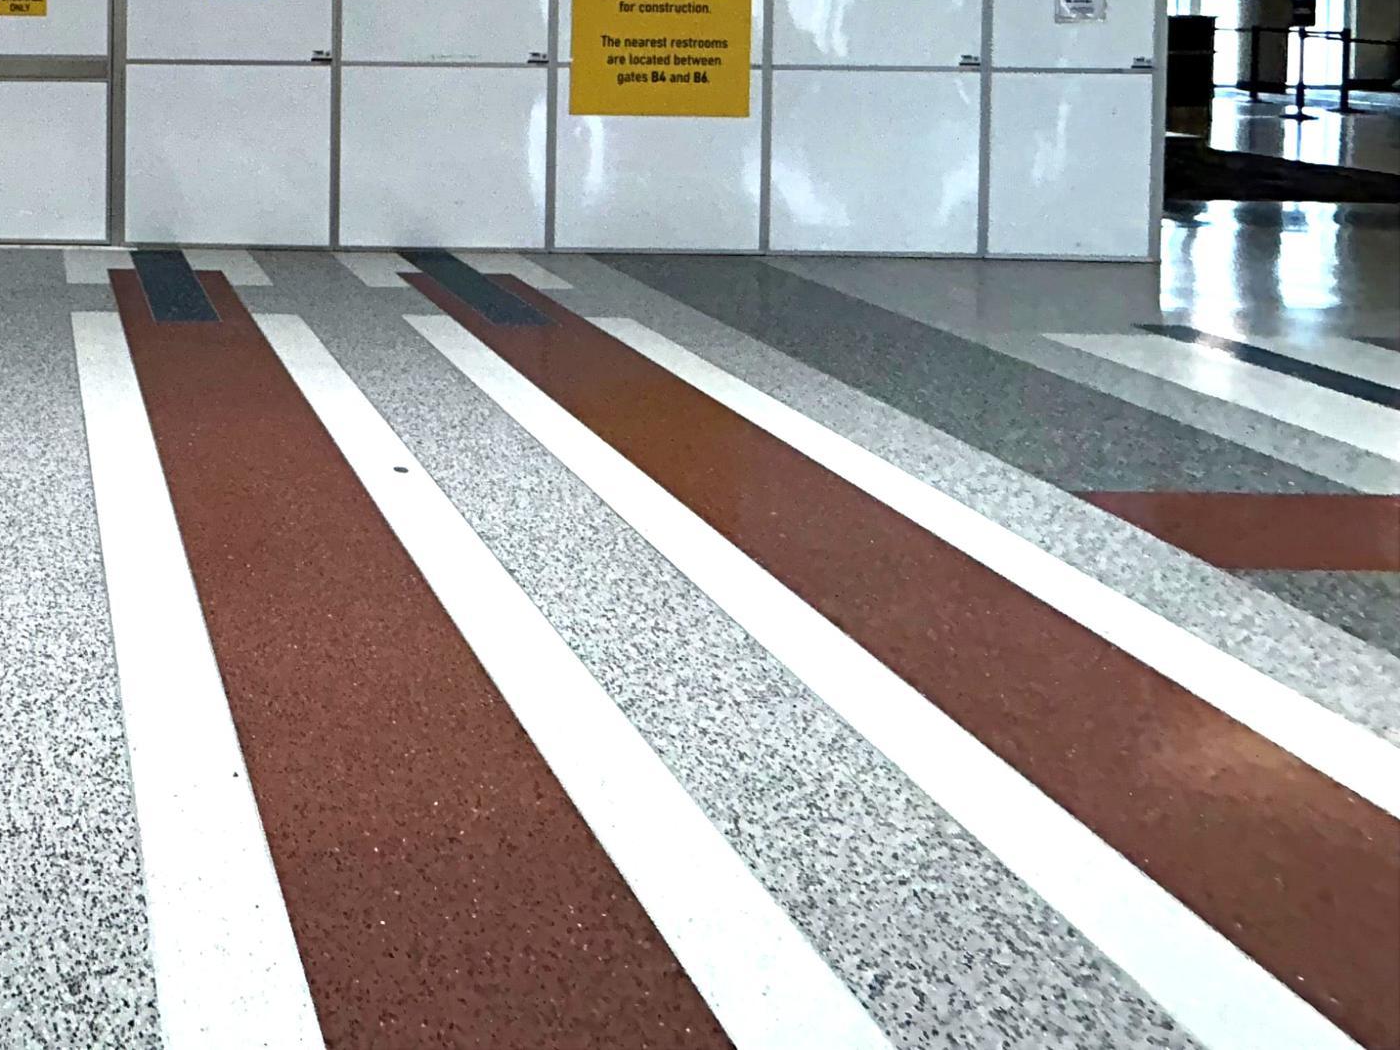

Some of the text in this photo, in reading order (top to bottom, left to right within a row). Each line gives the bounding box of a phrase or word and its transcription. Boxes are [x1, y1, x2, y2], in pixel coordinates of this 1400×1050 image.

[9, 3, 30, 12] ONLY
[619, 2, 711, 14] for construction.
[601, 35, 729, 48] The nearest restrooms
[606, 54, 722, 66] are located between
[617, 72, 648, 85] gates
[651, 71, 667, 83] B4
[669, 71, 690, 83] and
